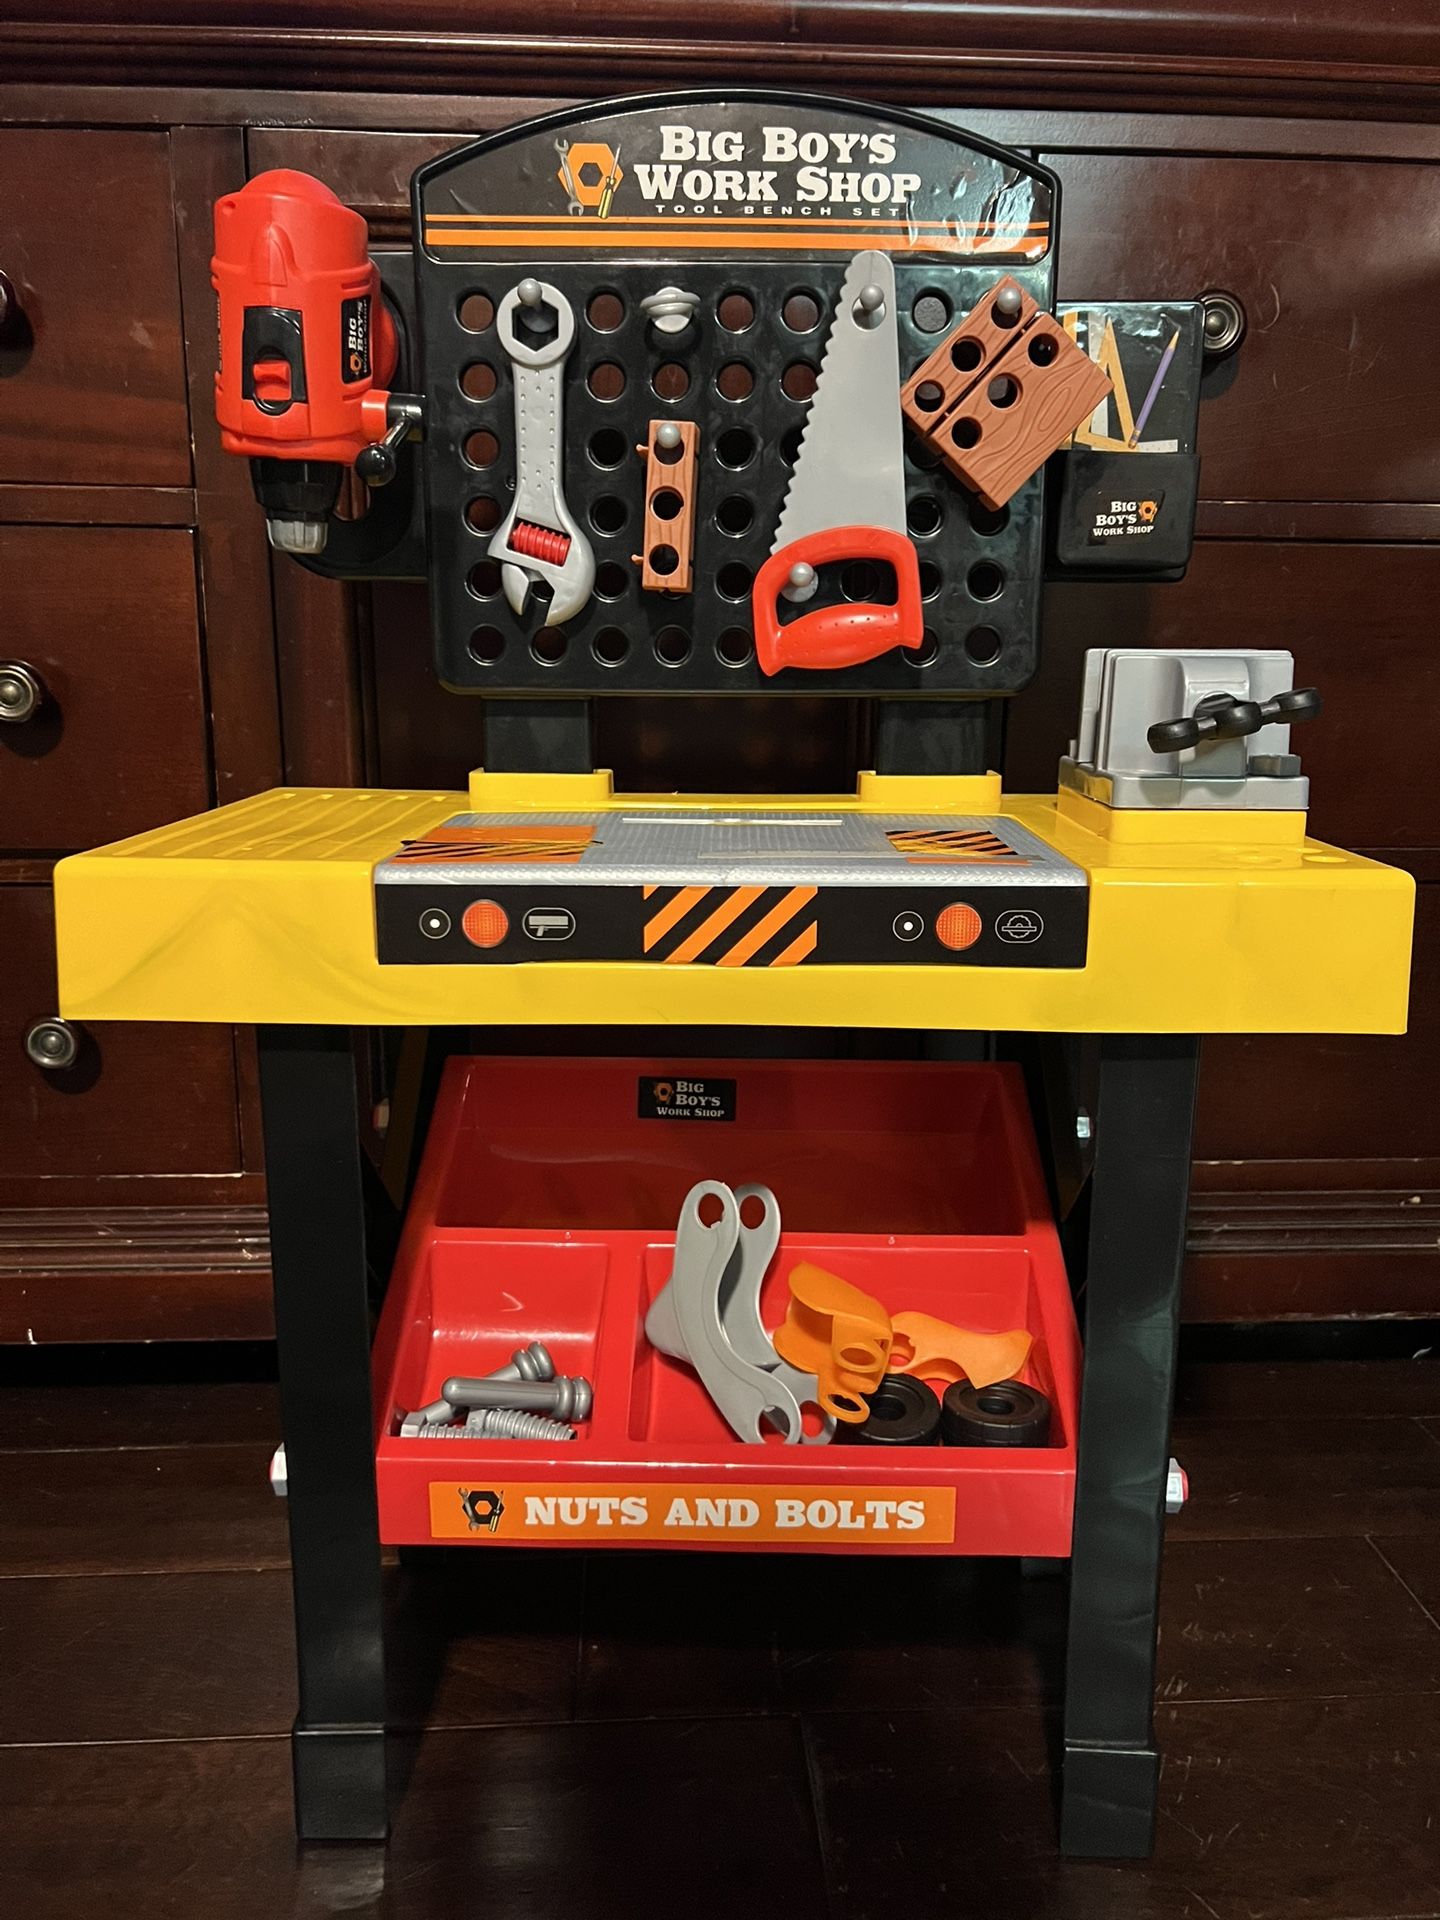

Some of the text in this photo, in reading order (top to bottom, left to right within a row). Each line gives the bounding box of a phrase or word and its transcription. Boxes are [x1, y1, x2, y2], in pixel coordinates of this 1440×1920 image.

[660, 125, 897, 164] BIG BOY'S
[633, 164, 922, 203] WORK SHOP
[655, 204, 900, 217] TOOL BENCH SET
[348, 317, 357, 350] BIG
[1110, 501, 1137, 513] BIG
[1095, 514, 1138, 526] BOY'S
[1092, 525, 1155, 537] WORK SHOP
[676, 1080, 705, 1093] BIG
[675, 1093, 721, 1107] BOY'S
[656, 1106, 725, 1117] WORK SHOP
[524, 1496, 926, 1529] NUTS AND BOLTS
